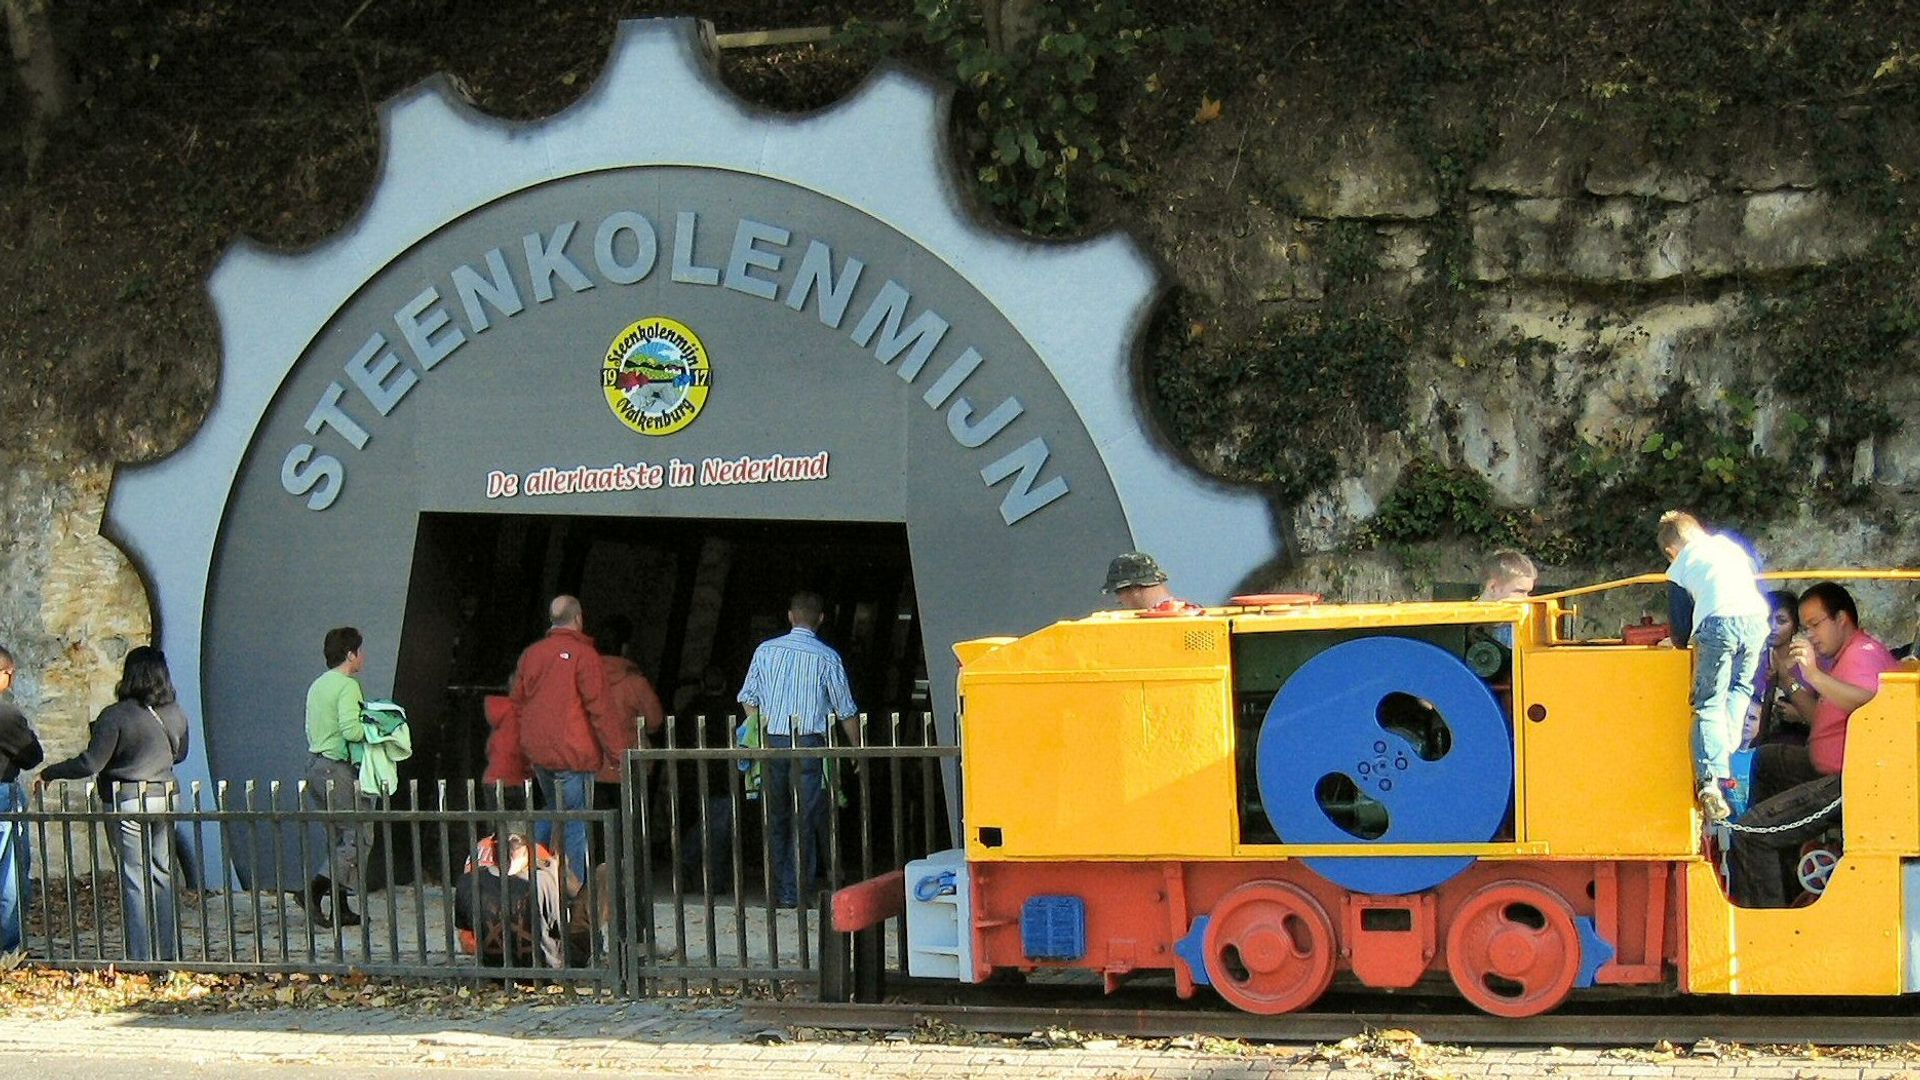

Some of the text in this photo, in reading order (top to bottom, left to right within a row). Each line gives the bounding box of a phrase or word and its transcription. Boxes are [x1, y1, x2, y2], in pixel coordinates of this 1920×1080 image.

[607, 322, 699, 367] Steenkolenmijn
[281, 211, 1070, 526] STEENKOLENMIJN
[602, 369, 708, 386] 19 17
[616, 397, 696, 432] Valkenburg
[487, 451, 828, 498] De allerlaatste in Nederland
